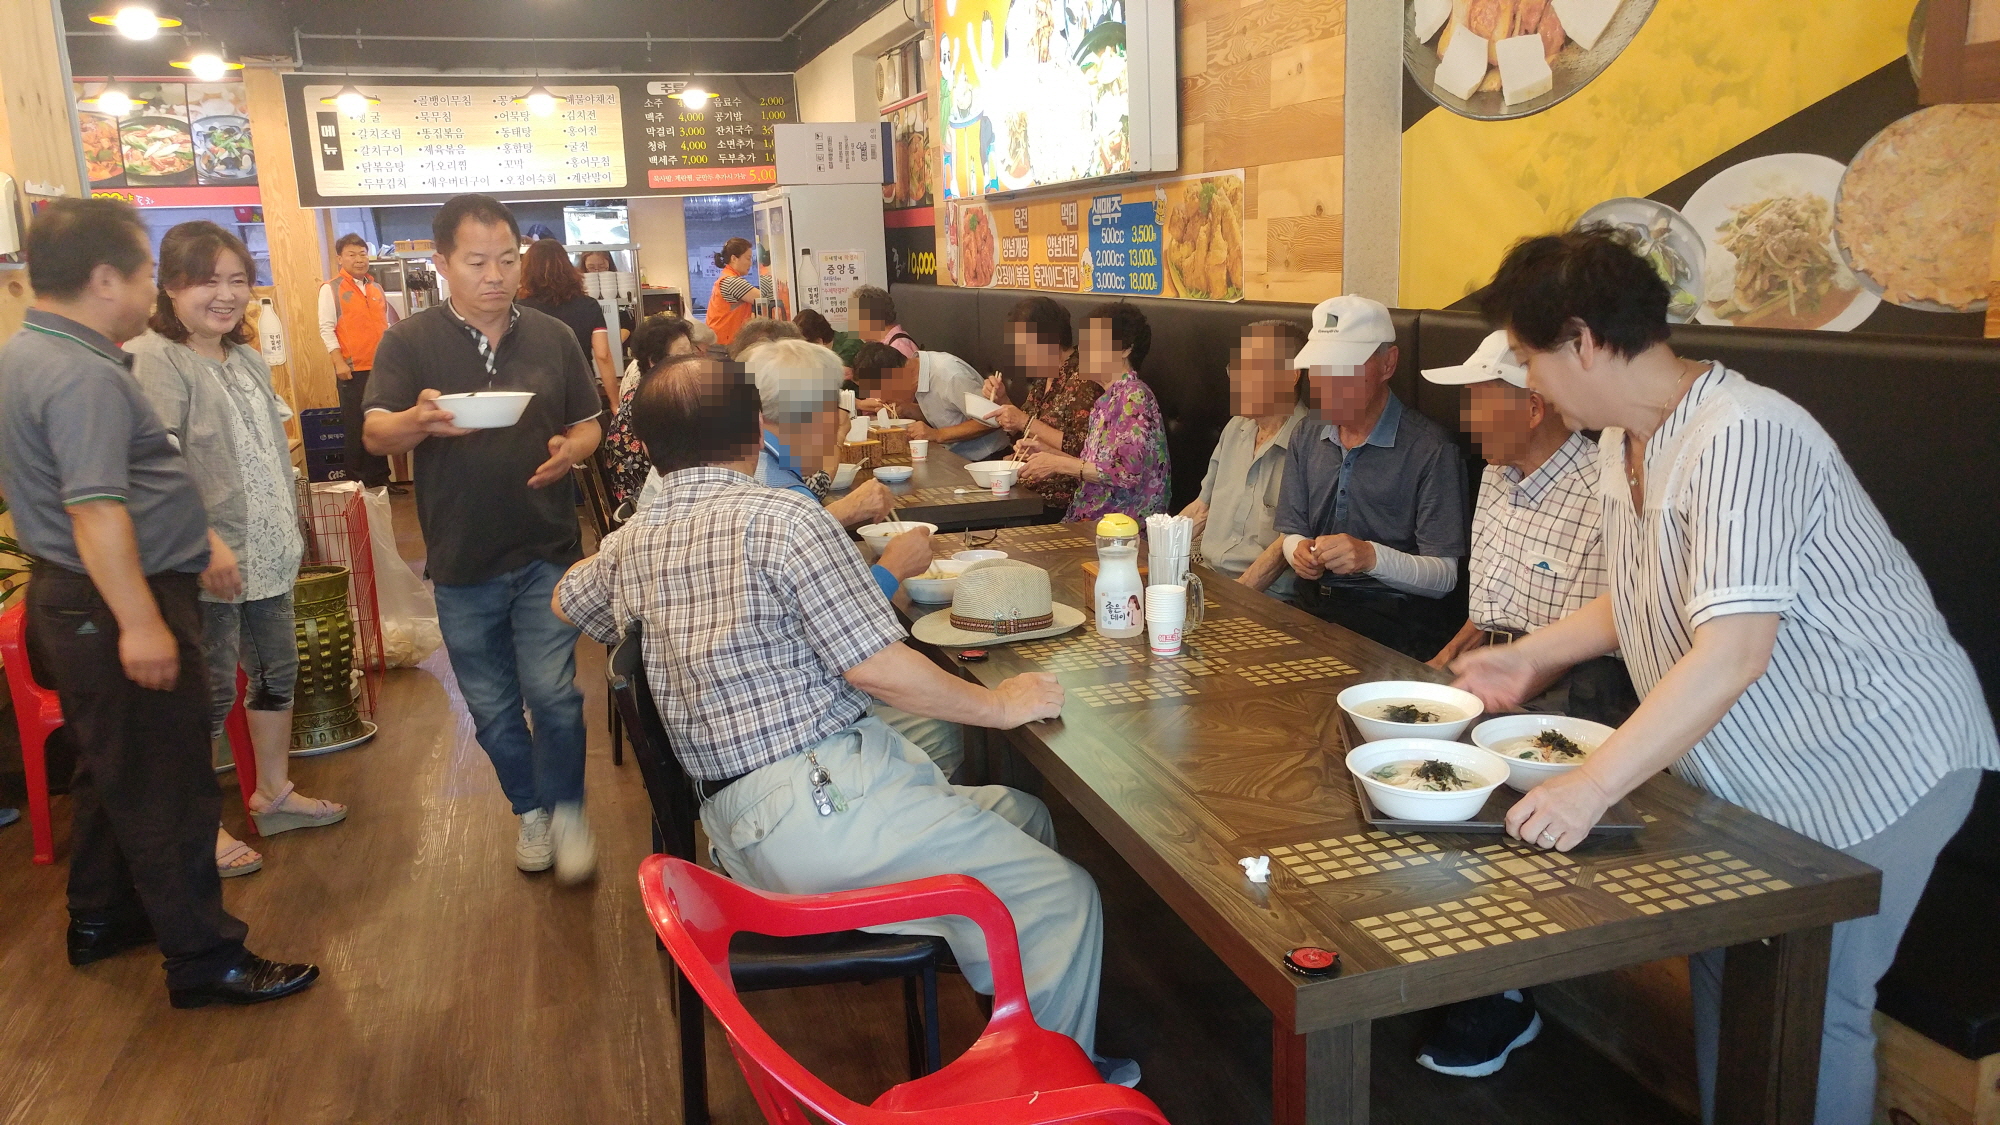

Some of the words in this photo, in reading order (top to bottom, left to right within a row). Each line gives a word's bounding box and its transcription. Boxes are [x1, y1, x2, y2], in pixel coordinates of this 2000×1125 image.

[419, 95, 471, 106] 골뱅이무침
[644, 98, 664, 108] 소주
[713, 97, 742, 108] 음료수
[760, 96, 784, 107] 2,000
[420, 111, 452, 122] 묵무침
[500, 111, 530, 121] 어묵탕
[567, 110, 597, 121] 김치전
[645, 112, 665, 123] 맥주
[678, 112, 704, 123] 4,000
[714, 111, 743, 123] 공기밥
[761, 110, 786, 121] 1,000
[358, 128, 401, 140] 갈치조림
[421, 127, 465, 140] 똥집볶음
[501, 126, 531, 138] 동태탕
[568, 125, 597, 137] 홍어전
[646, 126, 675, 137] 막걸리
[679, 126, 705, 137] 3,000
[715, 124, 754, 135] 잔치국수
[320, 125, 338, 155] 메뉴
[648, 141, 667, 151] 청하
[681, 140, 707, 151] 4,000
[717, 139, 755, 150] 소면추가
[360, 145, 403, 156] 갈치구이
[503, 143, 533, 154] 홍합탕
[570, 141, 588, 153] 굴전
[571, 156, 610, 168] 홍어무침
[649, 155, 678, 166] 백세주
[682, 155, 708, 165] 7,000
[718, 153, 756, 163] 두부추가
[361, 161, 404, 173] 닭볶음탕
[425, 159, 467, 171] 가오리찜
[364, 178, 407, 189] 두부김치
[428, 175, 490, 188] 새우버터구이
[506, 173, 557, 185] 오징어숙회
[572, 172, 611, 183] 계란말이
[1061, 202, 1078, 226] 먹태
[1092, 196, 1122, 226] 생맥주
[1014, 207, 1028, 229] 육전
[1101, 227, 1125, 244] 500cc
[1002, 237, 1029, 258] 양념게장
[1046, 234, 1078, 258] 양념치킨
[1095, 249, 1125, 268] 2,000cc
[1033, 264, 1079, 289] 후라이드치킨
[1095, 272, 1126, 291] 3,000cc
[830, 307, 848, 315] 4,000
[1105, 601, 1122, 615] 좋은
[1109, 612, 1126, 621] 데이
